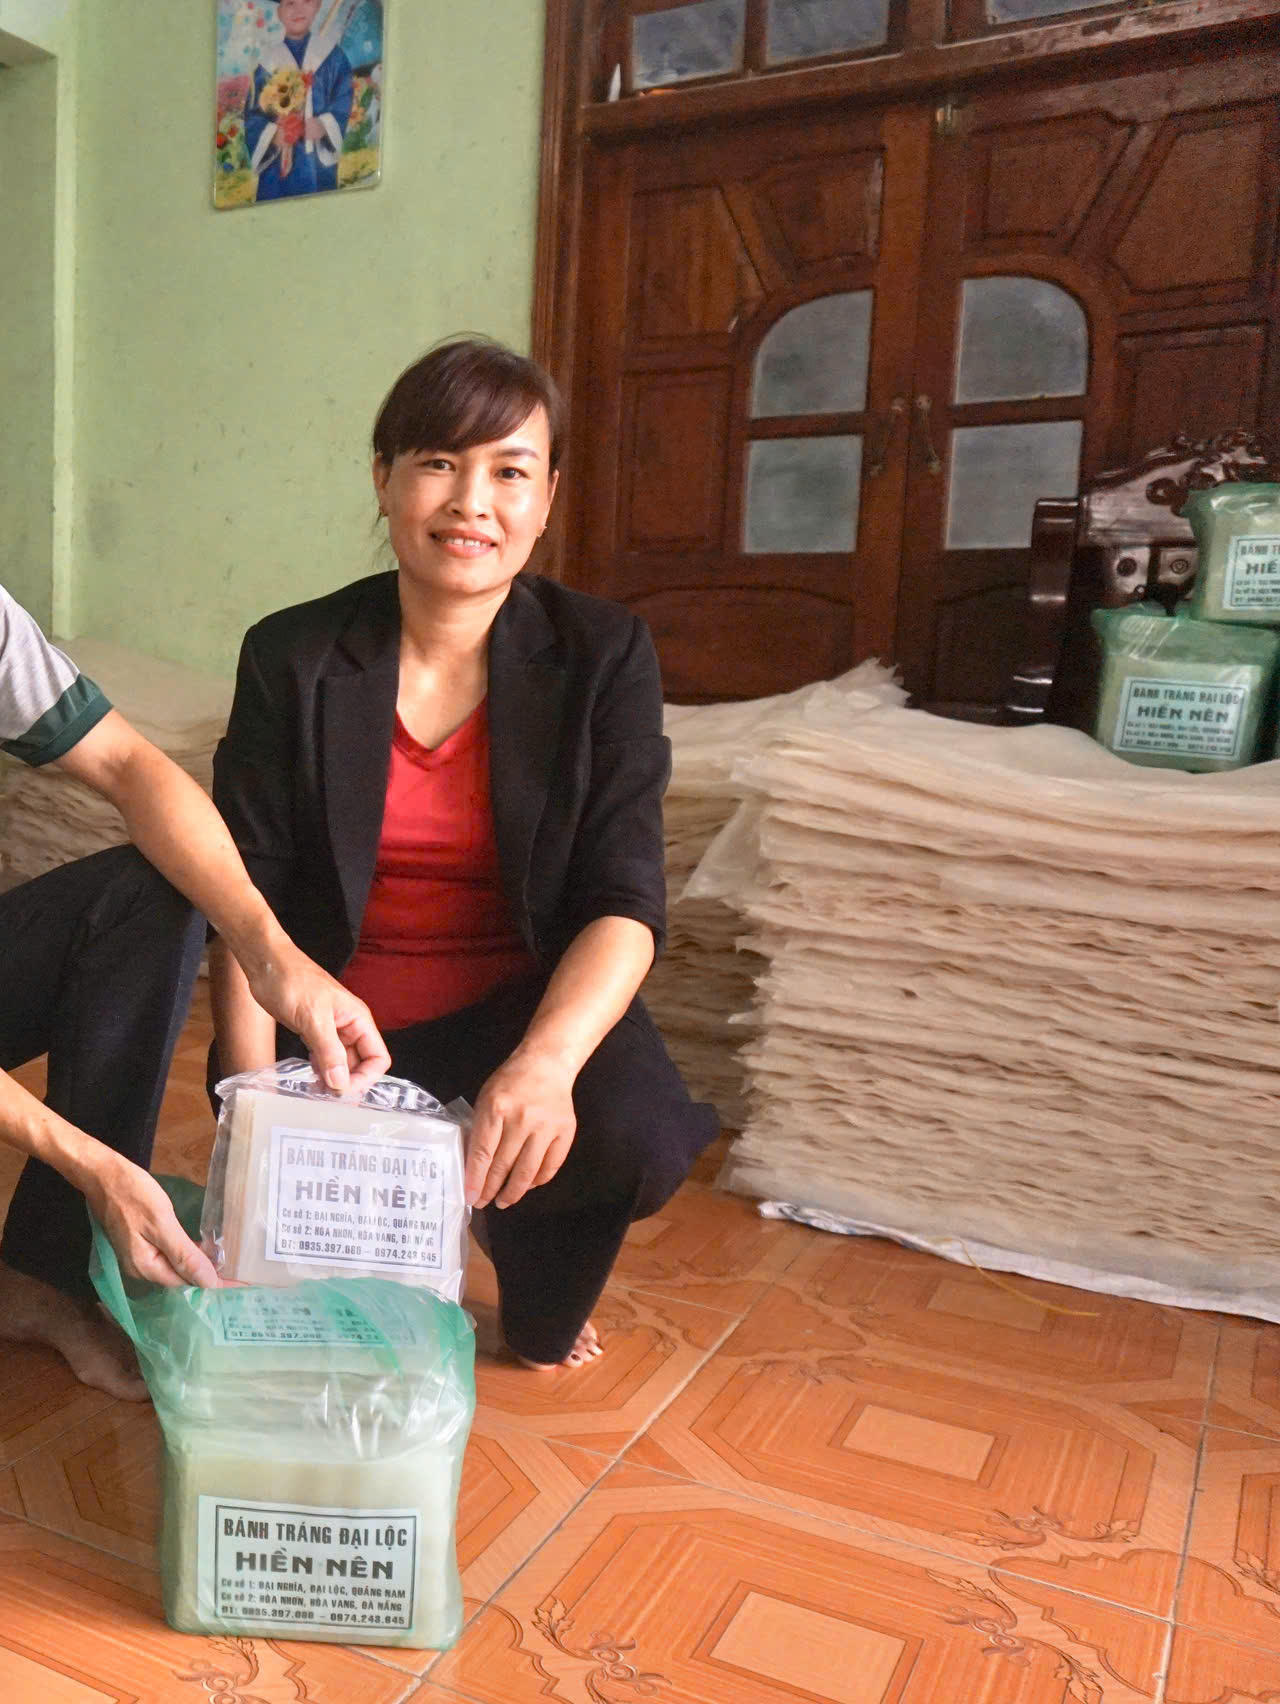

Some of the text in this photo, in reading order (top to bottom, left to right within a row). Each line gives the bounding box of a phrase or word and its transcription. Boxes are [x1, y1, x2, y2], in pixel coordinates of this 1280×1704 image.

[287, 1146, 324, 1168] BÁNH
[331, 1151, 376, 1172] TRÁNG
[382, 1157, 407, 1178] ĐẠI
[296, 1176, 428, 1211] HIỀN NÊN
[306, 1210, 312, 1220] 1:
[305, 1225, 312, 1235] 2:
[224, 1517, 407, 1549] BÁNH TRÁNG ĐẠI LỘC
[236, 1548, 393, 1579] HIỀN NÊN
[259, 1581, 274, 1591] ĐẠI
[310, 1585, 326, 1594] ĐẠI
[329, 1584, 348, 1596] LỘC,
[352, 1585, 382, 1597] QUẢNG
[385, 1589, 406, 1598] NAM
[259, 1593, 277, 1604] HÒA
[310, 1598, 328, 1607] HÒA
[331, 1599, 358, 1610] VANG,
[362, 1599, 374, 1610] ĐÀ
[377, 1600, 402, 1611] NẴNG
